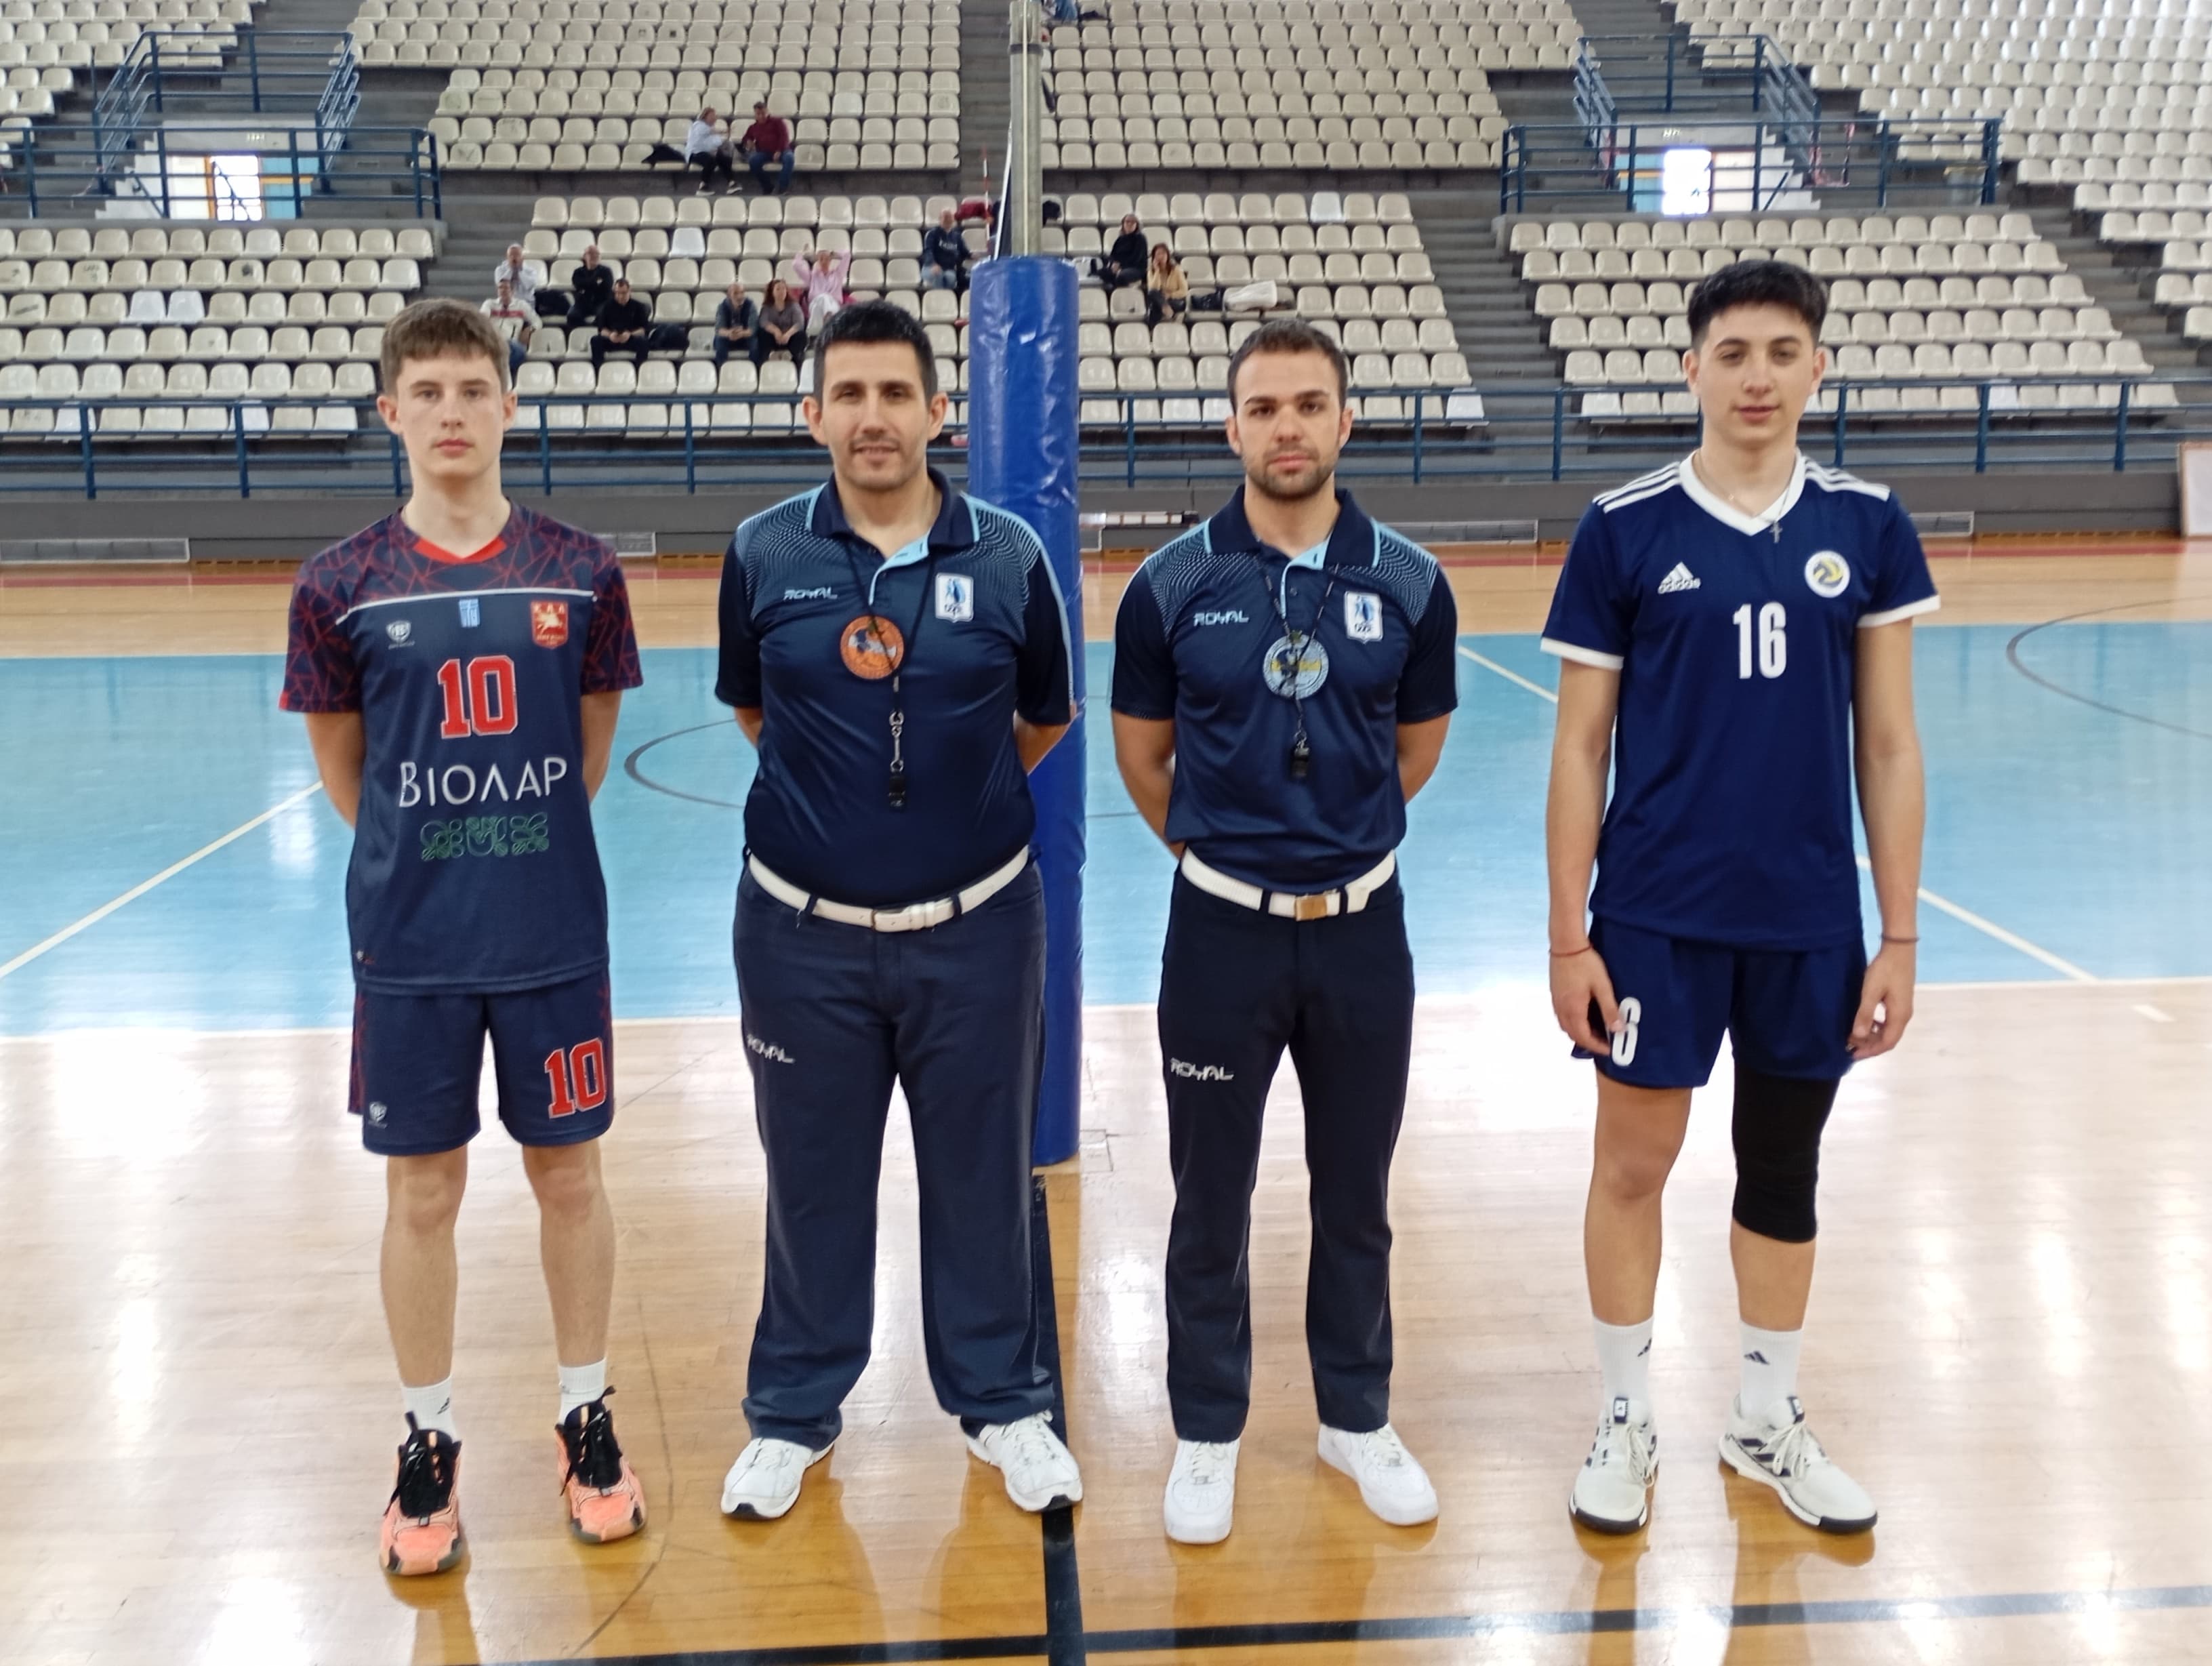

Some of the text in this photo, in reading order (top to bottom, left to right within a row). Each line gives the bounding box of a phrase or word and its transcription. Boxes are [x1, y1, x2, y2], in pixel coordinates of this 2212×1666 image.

[783, 586, 838, 601] ROYAL
[1193, 610, 1250, 626] ROYAL
[1733, 601, 1787, 678] 16
[437, 655, 518, 739] 10
[1607, 996, 1641, 1066] 6
[544, 1037, 607, 1120] 10
[1170, 1057, 1234, 1081] ROYAL
